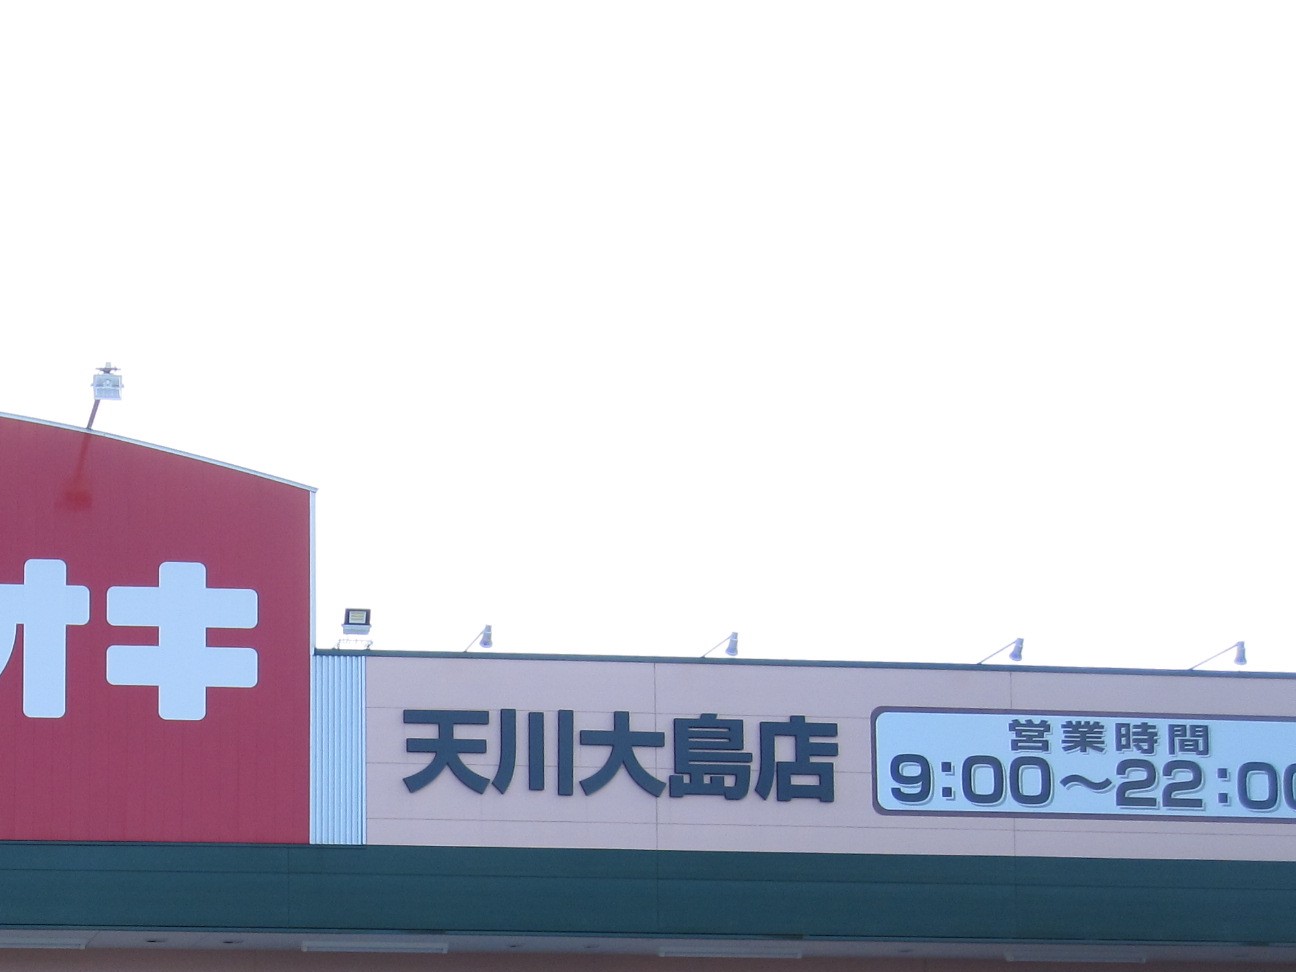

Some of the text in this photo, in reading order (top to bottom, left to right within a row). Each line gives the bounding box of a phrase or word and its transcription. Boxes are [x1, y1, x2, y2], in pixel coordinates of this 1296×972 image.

[402, 708, 840, 804] 天川大島店
[1008, 719, 1210, 756] 営業時間
